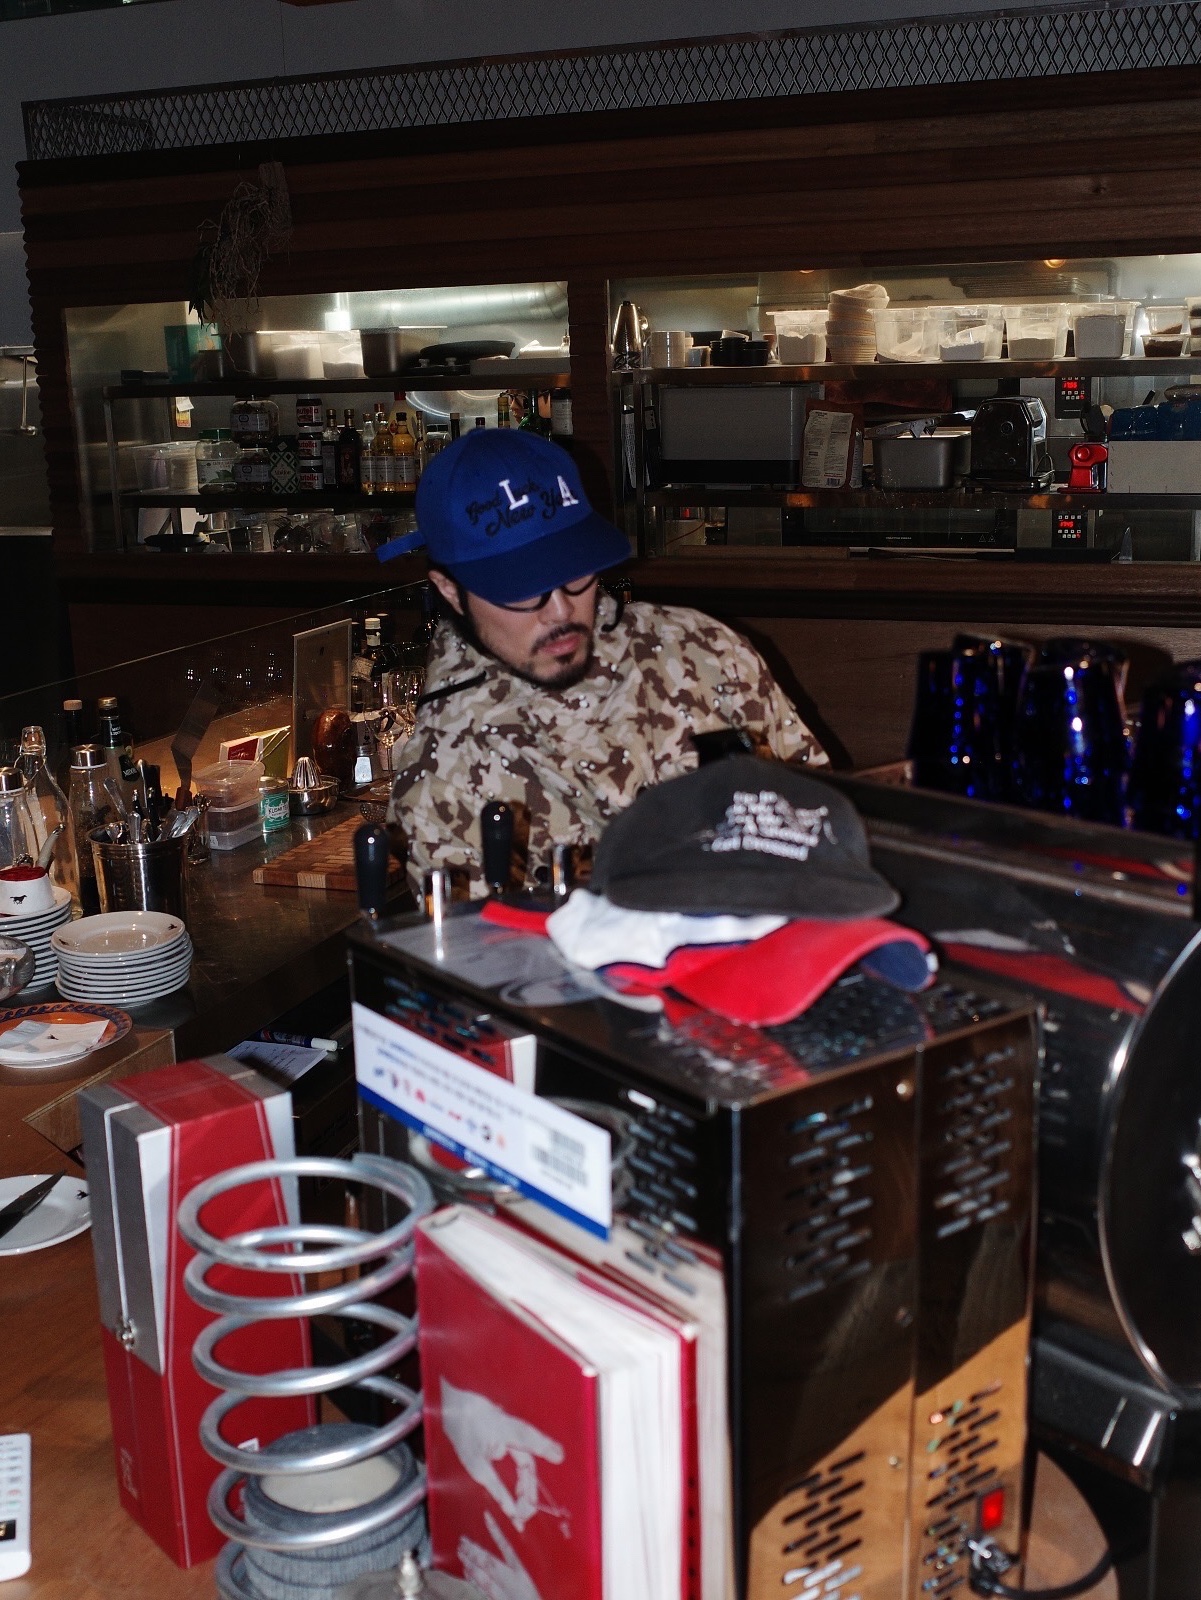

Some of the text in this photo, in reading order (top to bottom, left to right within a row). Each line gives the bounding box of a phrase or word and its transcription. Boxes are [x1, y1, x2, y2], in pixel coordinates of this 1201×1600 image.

[299, 473, 319, 481] utella
[498, 475, 579, 511] L A
[485, 504, 537, 538] New
